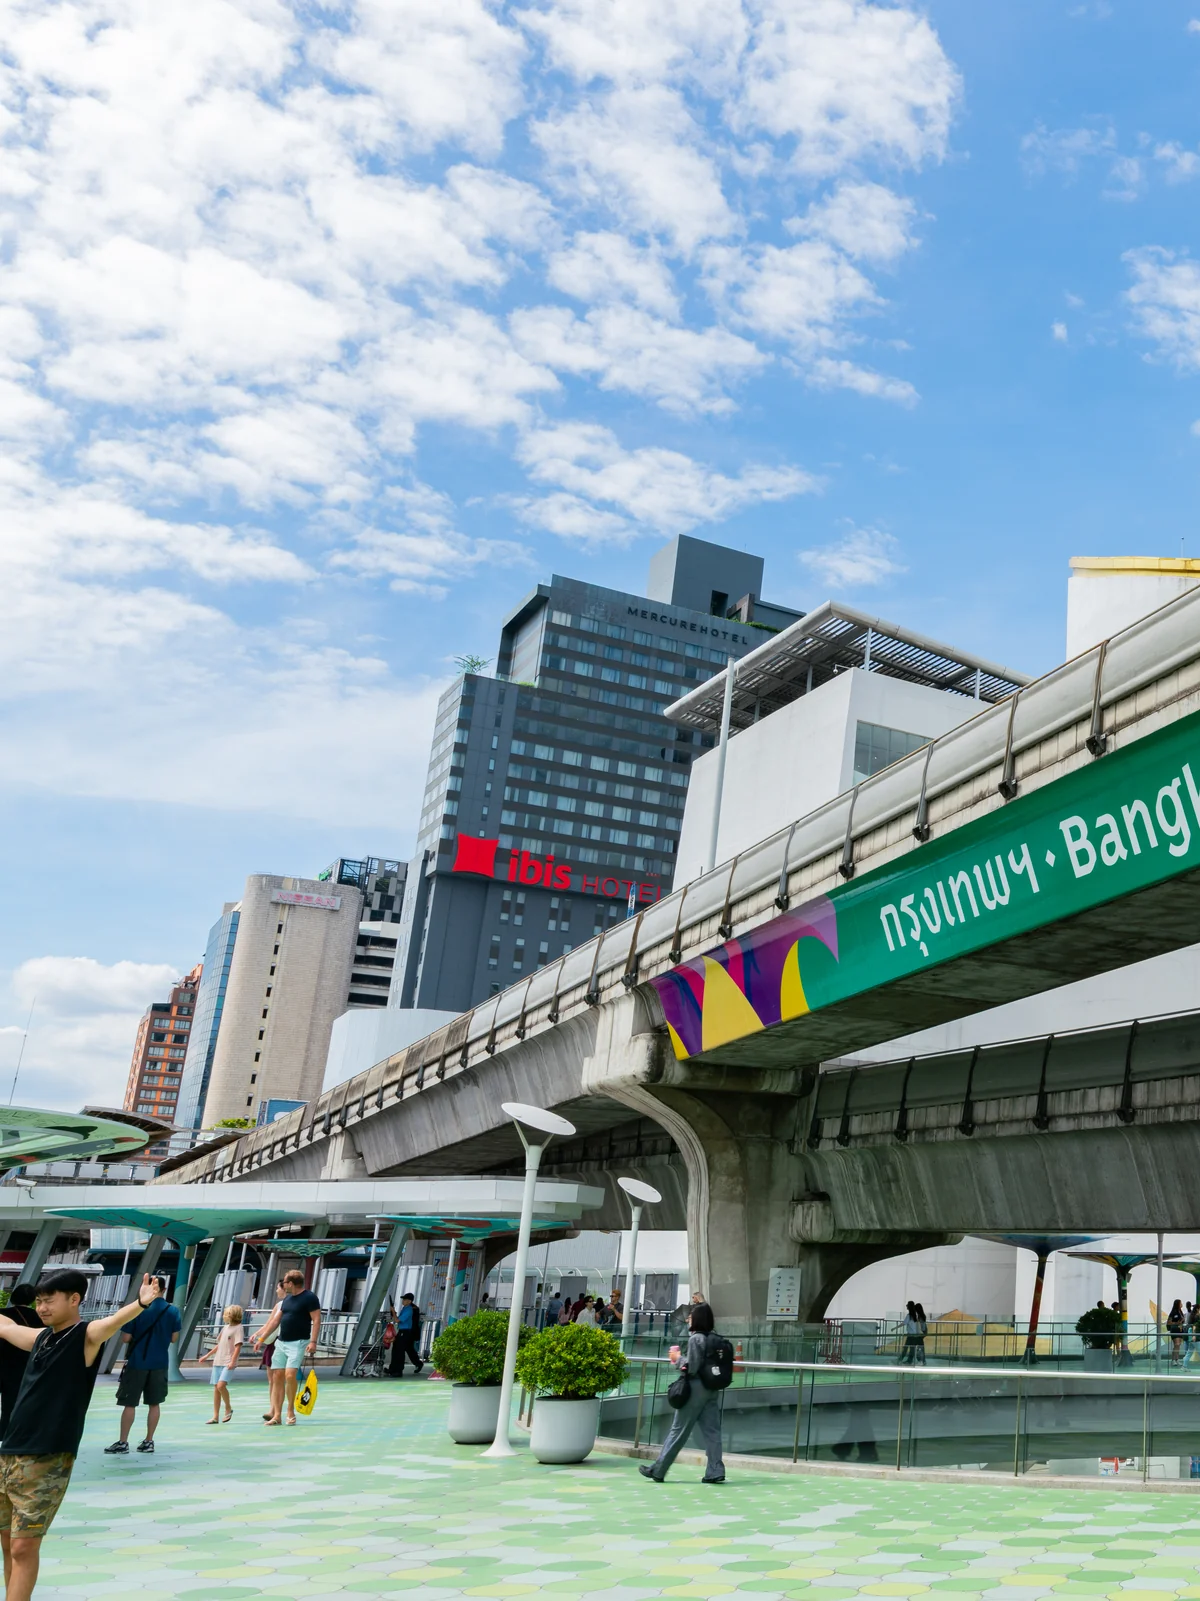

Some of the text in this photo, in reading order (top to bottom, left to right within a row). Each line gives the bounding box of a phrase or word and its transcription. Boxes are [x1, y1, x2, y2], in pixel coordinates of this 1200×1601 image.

[507, 848, 572, 890] ibis
[276, 891, 337, 907] NISSAN
[880, 843, 1040, 957] กรุงเทพฯ
